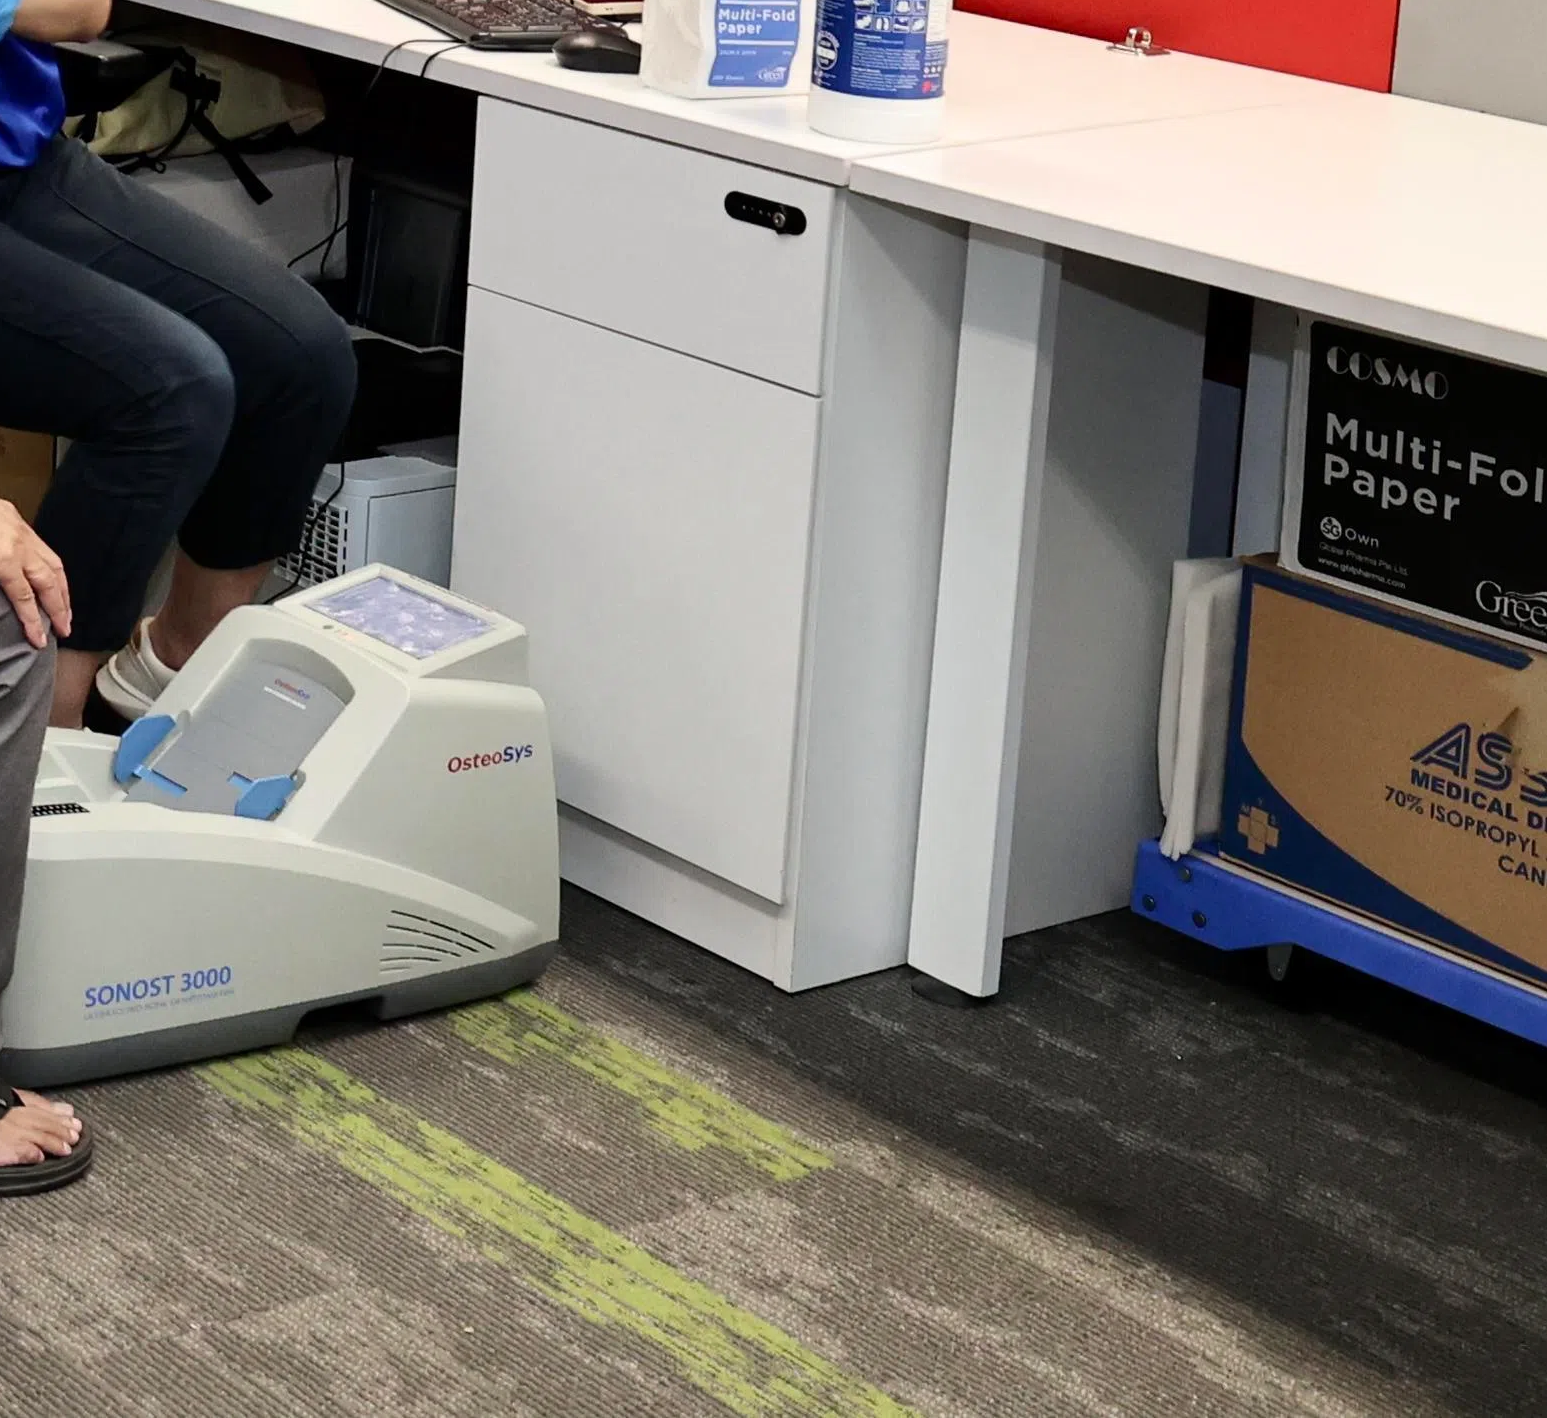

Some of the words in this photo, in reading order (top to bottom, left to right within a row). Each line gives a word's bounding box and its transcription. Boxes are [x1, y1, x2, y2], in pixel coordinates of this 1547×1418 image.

[718, 8, 796, 22] Multi-Fold
[718, 22, 763, 36] Paper
[1326, 346, 1449, 400] COSMO
[1326, 412, 1546, 503] Multi-Fol
[1324, 453, 1460, 521] Paper
[1344, 527, 1380, 548] Own
[1475, 580, 1547, 629] Gree
[447, 744, 533, 774] OsteoSys
[1410, 768, 1519, 823] MEDICAL
[1384, 785, 1425, 815] 70%
[1430, 802, 1540, 859] ISOPROPYL
[84, 974, 175, 1008] SONOST
[180, 965, 232, 993] 3000
